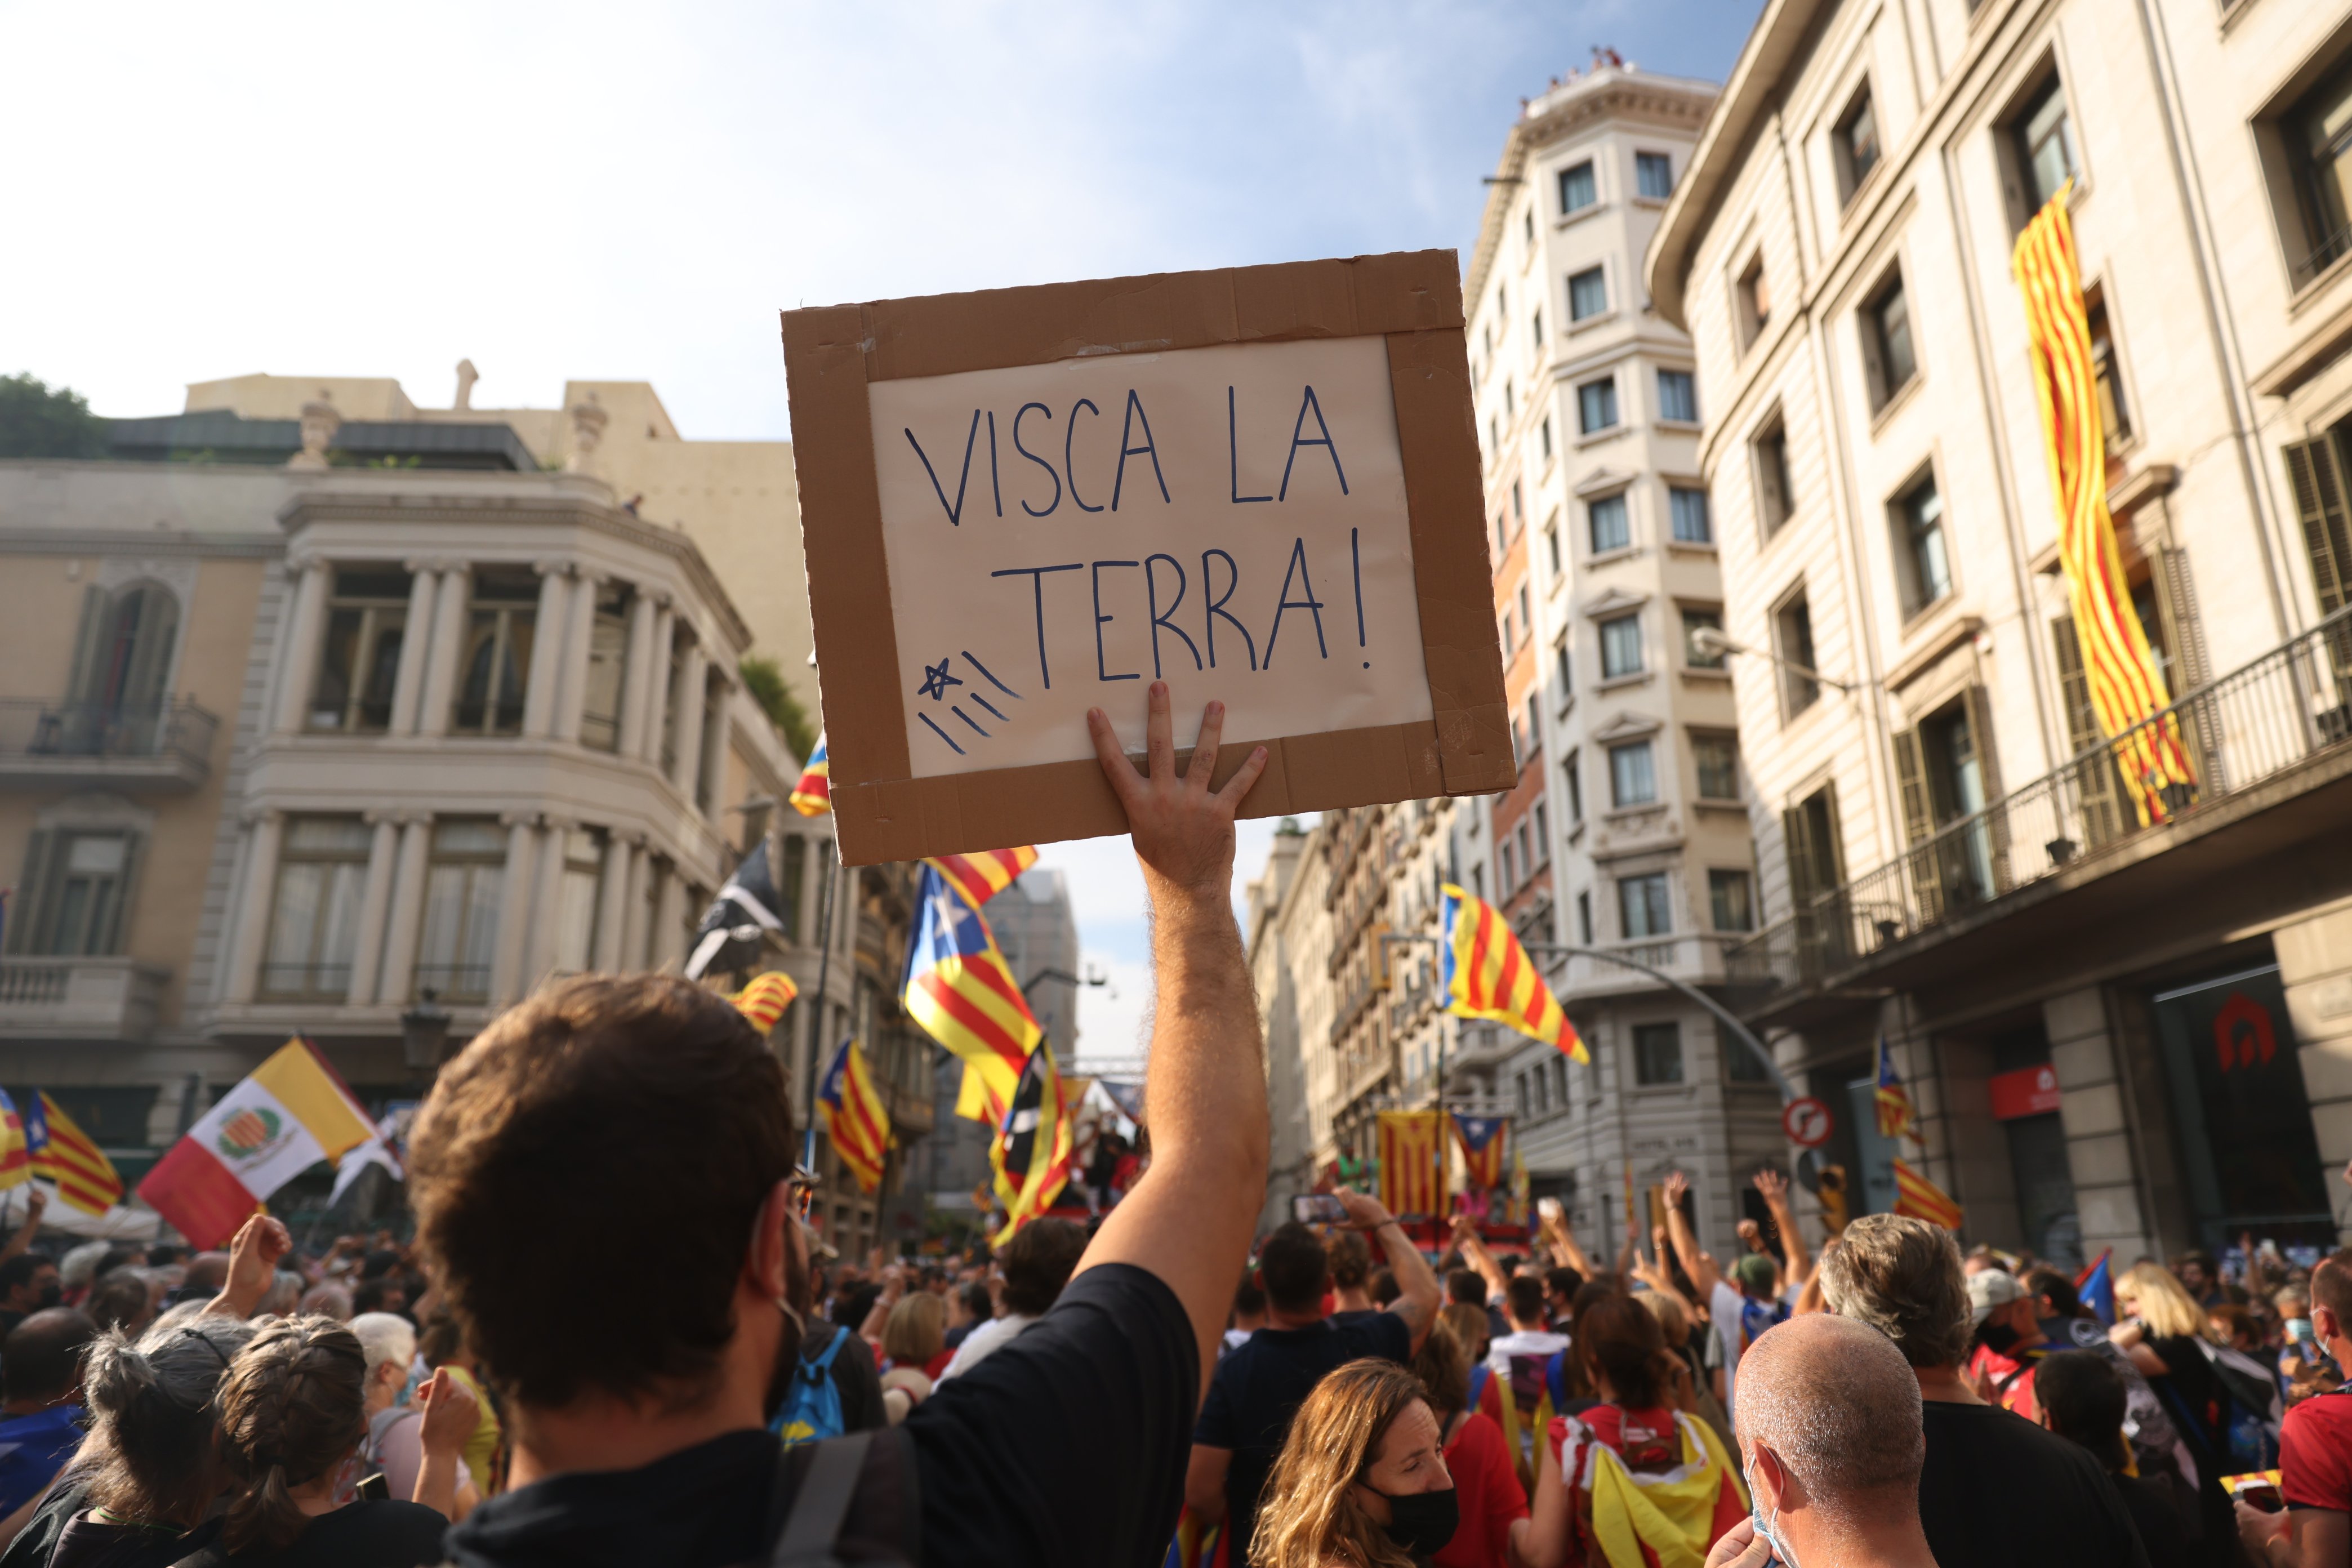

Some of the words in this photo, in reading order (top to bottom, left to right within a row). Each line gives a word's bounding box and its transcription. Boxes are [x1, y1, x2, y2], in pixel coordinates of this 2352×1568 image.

[904, 388, 1171, 527] VISCA
[1227, 385, 1349, 504] LA
[991, 527, 1371, 690] TERRA!
